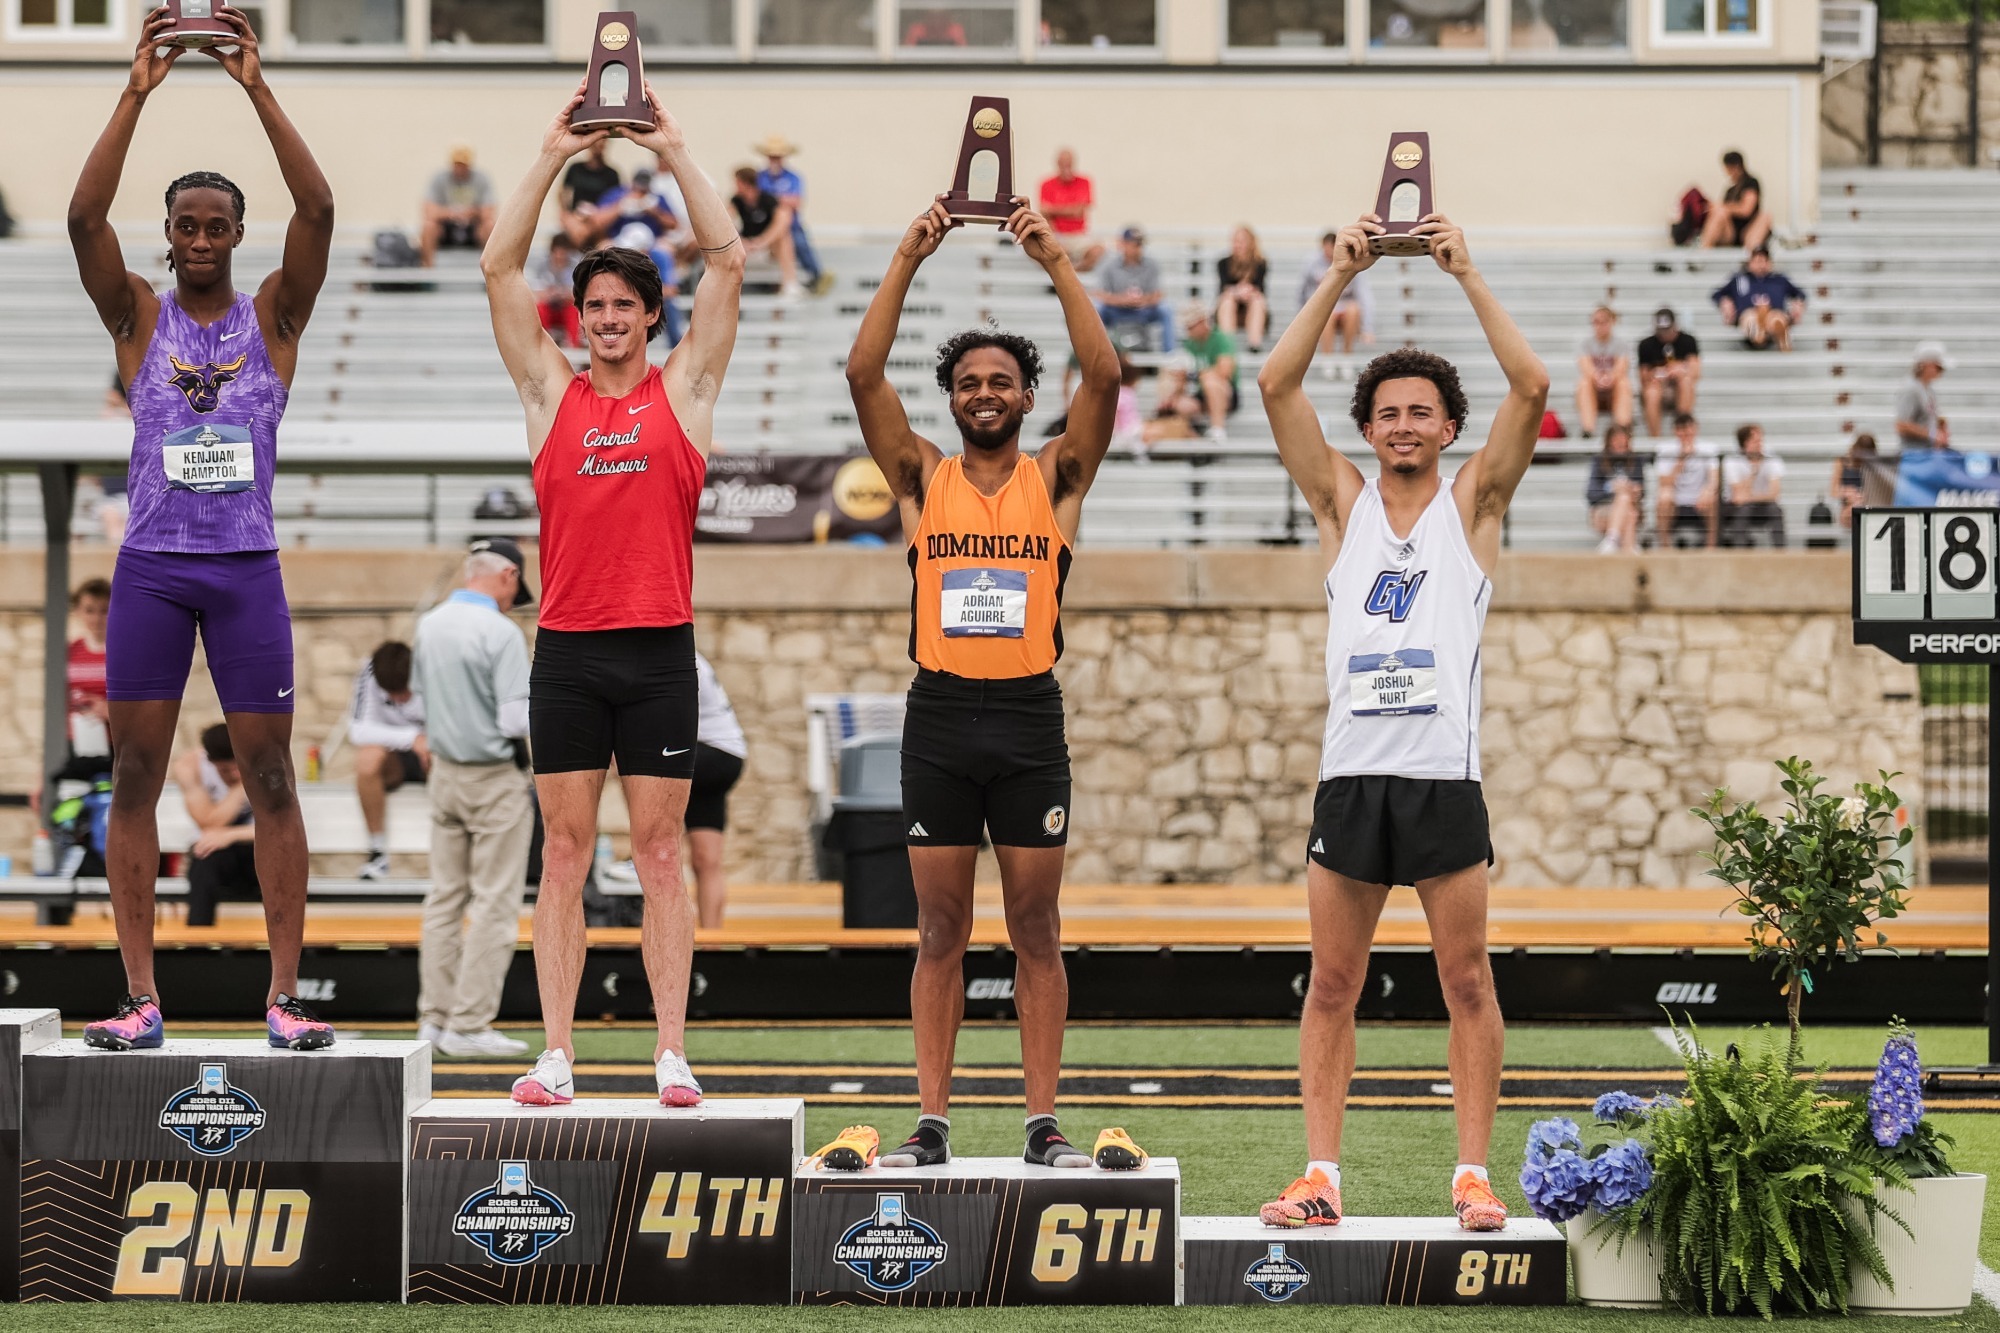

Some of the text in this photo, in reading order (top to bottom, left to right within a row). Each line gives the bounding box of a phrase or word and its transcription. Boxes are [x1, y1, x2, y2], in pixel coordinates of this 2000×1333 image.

[602, 34, 628, 43] NCAA
[974, 120, 1002, 131] NCAA
[1394, 153, 1420, 162] NCAA
[583, 422, 641, 447] Central
[184, 450, 234, 464] KENJUAN
[577, 453, 648, 476] Missouri
[183, 465, 237, 480] HAMPTON
[927, 533, 1049, 561] DOMINICAN
[963, 595, 1004, 608] ADRIAN
[1364, 568, 1428, 623] GV
[960, 610, 1006, 623] AGUIRRE
[1372, 675, 1414, 690] JOSHUA
[1379, 691, 1407, 705] HURT
[297, 979, 337, 1001] ILL
[966, 978, 1015, 1000] GIL
[1656, 982, 1718, 1004] GILL
[162, 1112, 263, 1126] CHAMPIONSHIPS
[477, 1206, 505, 1214] OUTDOOR
[506, 1206, 526, 1214] TRACK
[532, 1206, 551, 1214] FIELD
[488, 1199, 540, 1207] 2026 DII
[638, 1172, 784, 1259] 4TH
[456, 1216, 571, 1231] CHAMPIONSHIPS
[112, 1181, 311, 1295] 2ND
[856, 1236, 883, 1244] OUTDOOR
[883, 1236, 902, 1244] TRACK
[908, 1236, 925, 1244] FIELD
[1031, 1203, 1162, 1282] 6TH
[837, 1245, 944, 1259] CHAMPIONSHIPS
[1246, 1273, 1308, 1282] CHAMPIONSHIPS
[1455, 1250, 1532, 1296] 8TH
